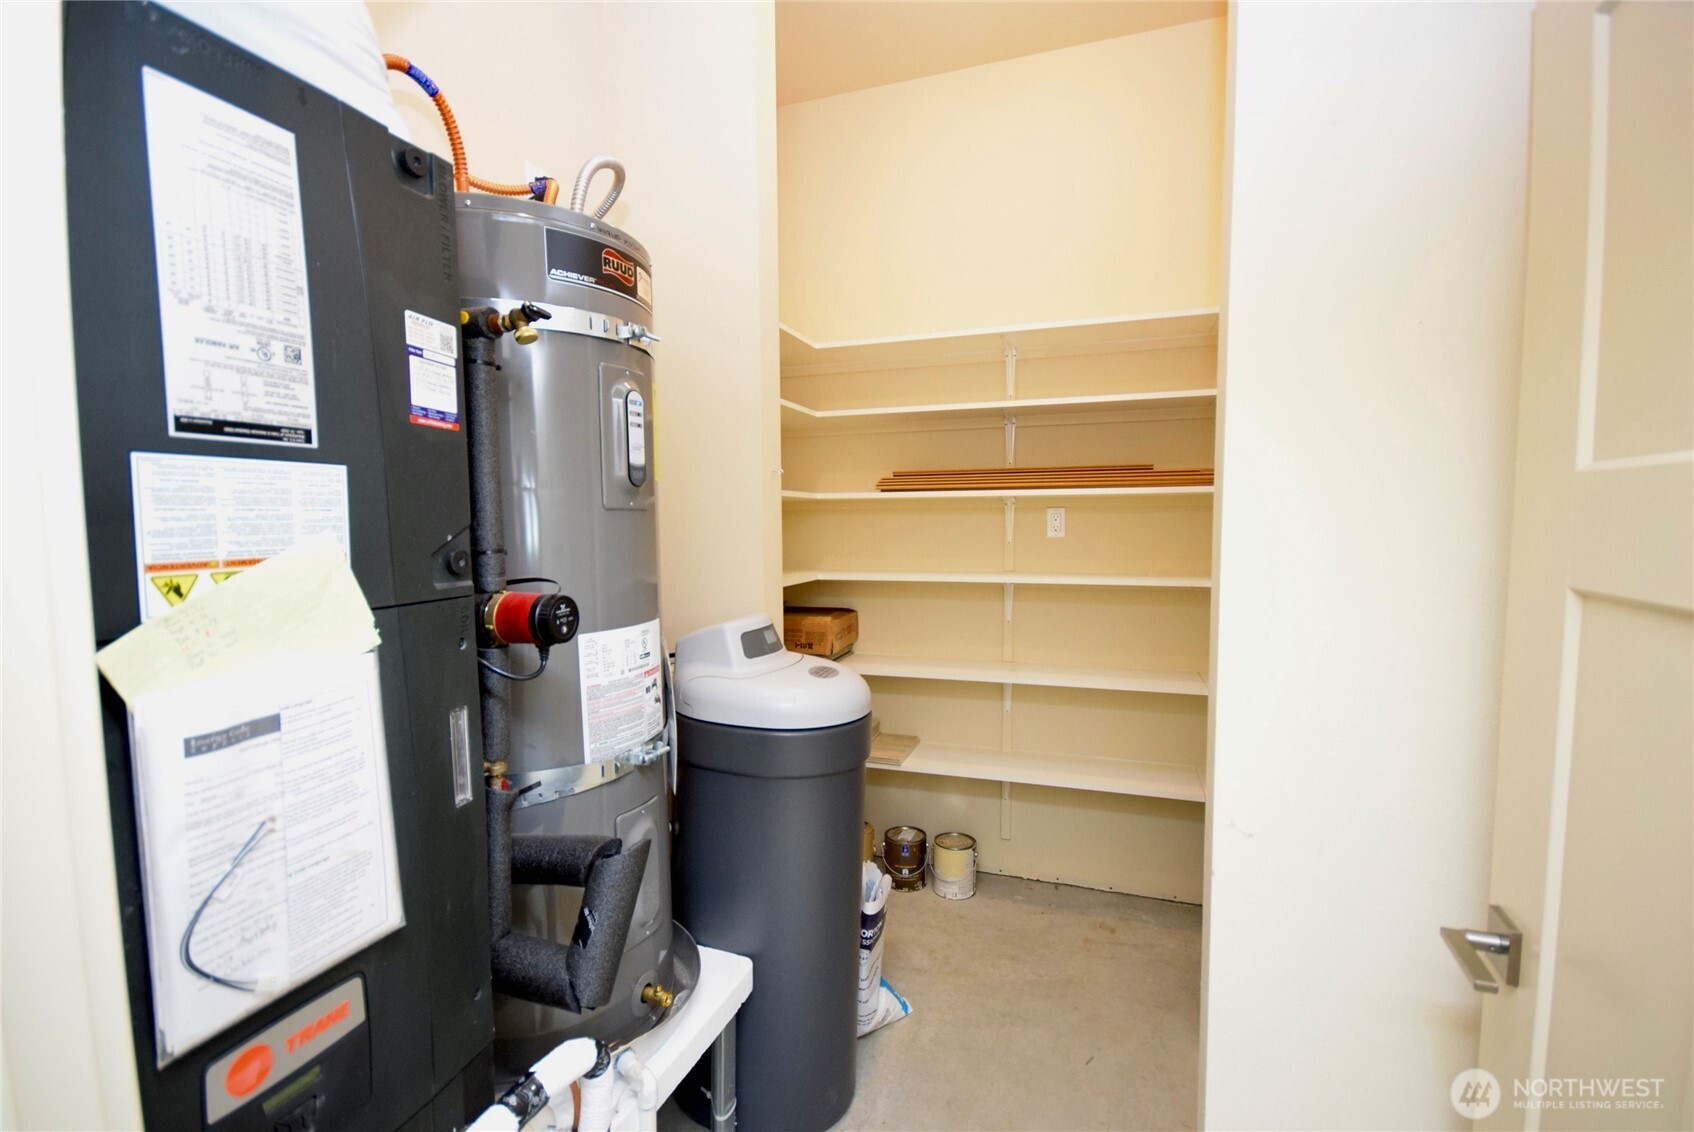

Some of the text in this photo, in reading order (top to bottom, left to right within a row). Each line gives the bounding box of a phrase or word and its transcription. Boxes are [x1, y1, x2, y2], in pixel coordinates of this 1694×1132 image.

[439, 163, 450, 223] BLOWER
[441, 233, 453, 282] FILTER
[550, 268, 595, 284] ACHIEVER
[603, 256, 634, 279] RUUD
[286, 1000, 350, 1055] TRANE
